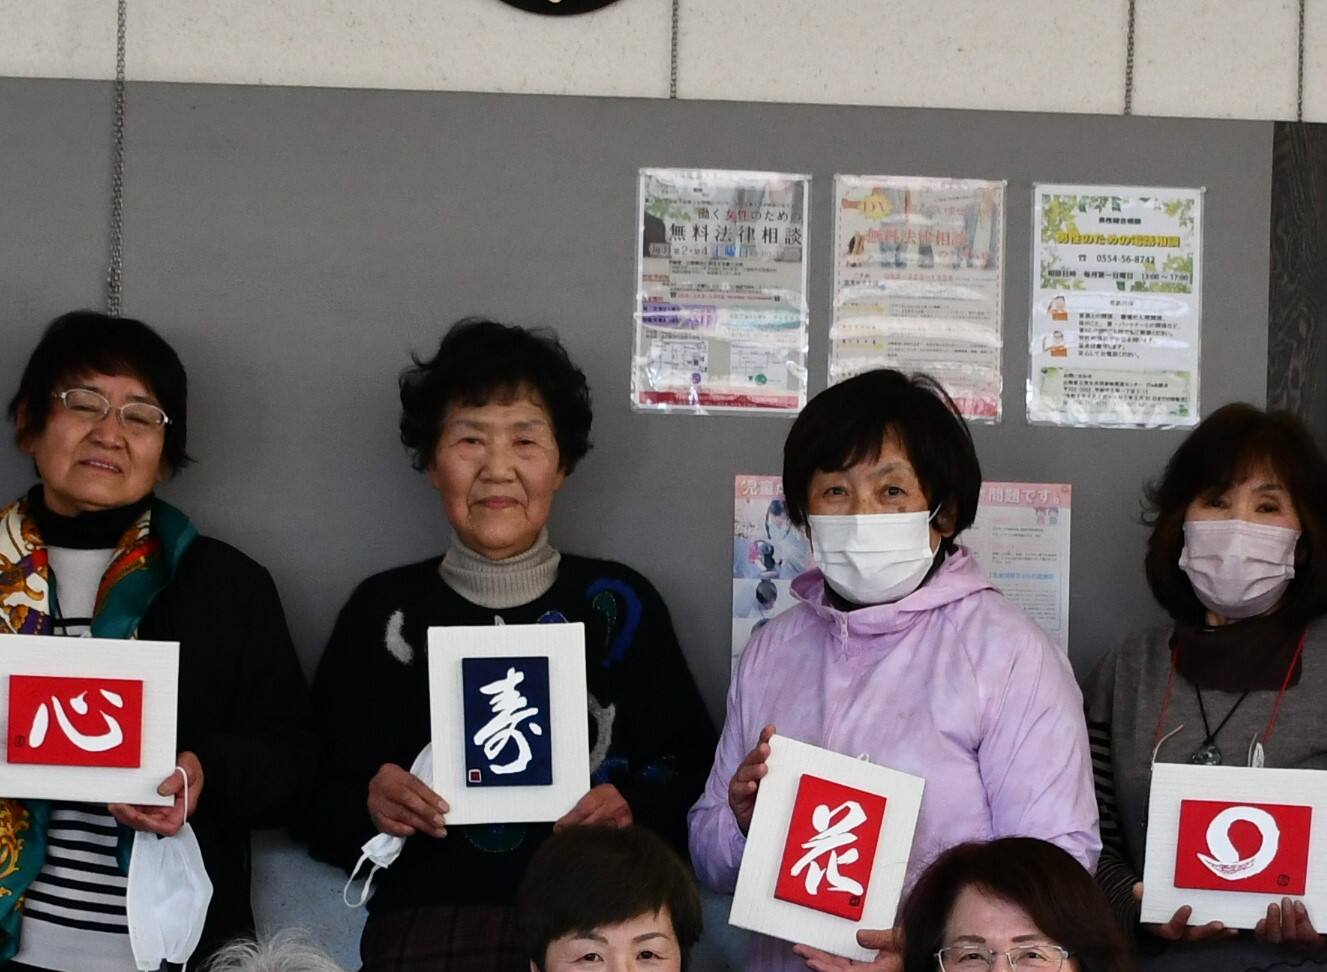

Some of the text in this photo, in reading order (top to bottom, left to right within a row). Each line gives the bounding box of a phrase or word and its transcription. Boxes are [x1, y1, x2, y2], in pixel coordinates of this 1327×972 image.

[669, 223, 802, 246] 無料法律相談
[980, 487, 1060, 504] 問題です。
[29, 688, 123, 752] 心
[473, 667, 542, 774] 寿
[790, 800, 867, 896] 花
